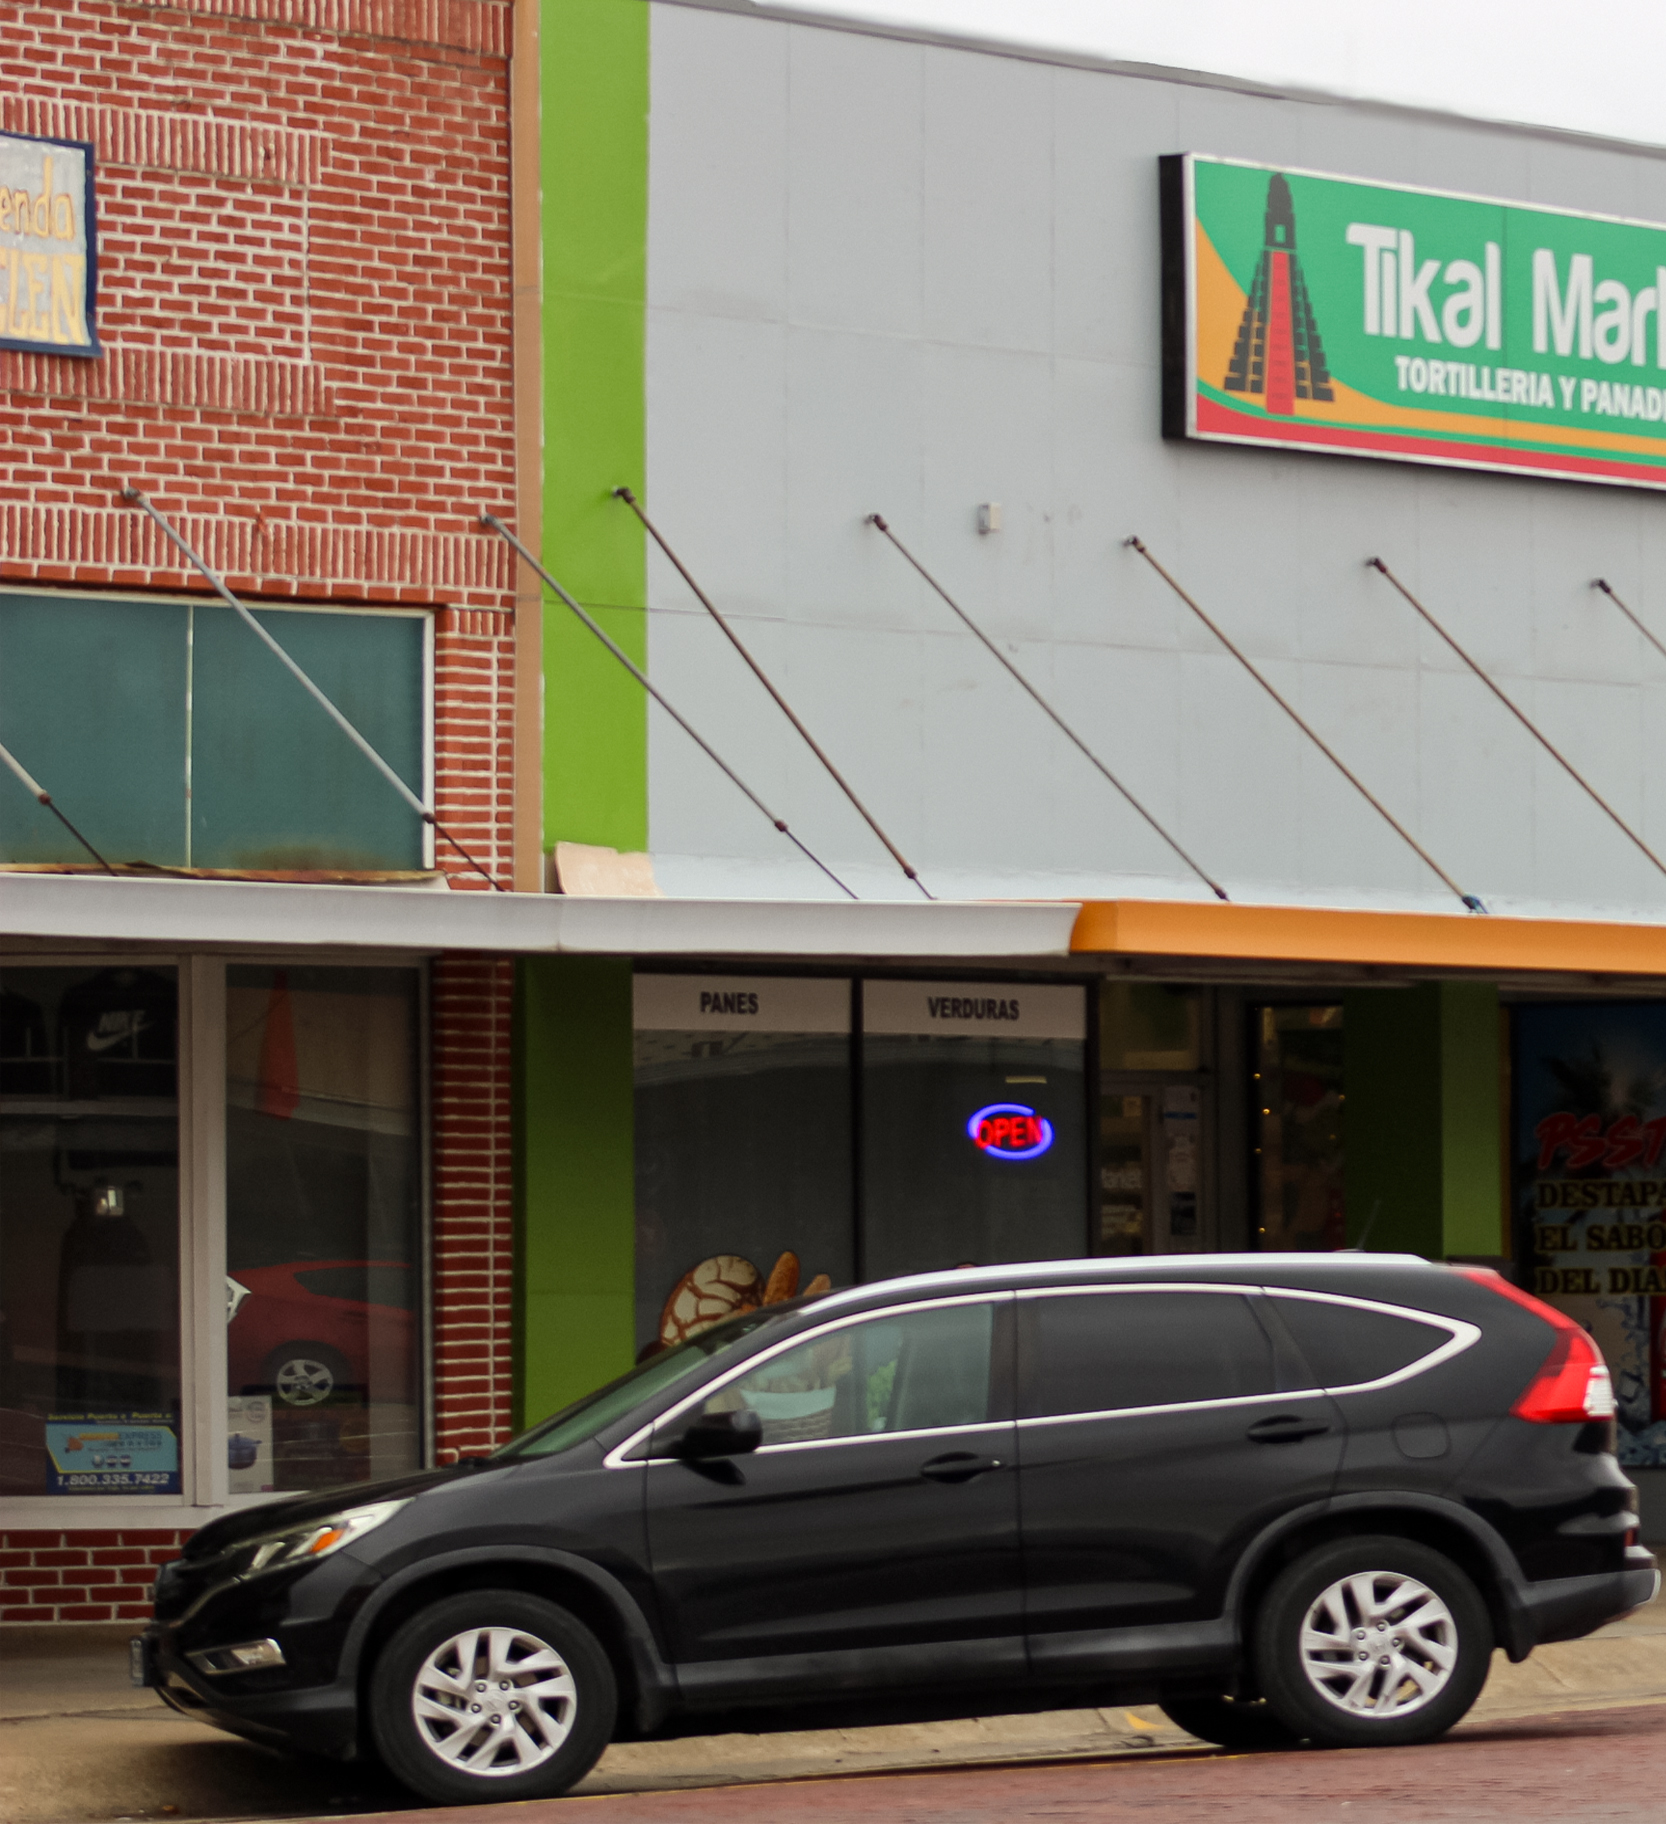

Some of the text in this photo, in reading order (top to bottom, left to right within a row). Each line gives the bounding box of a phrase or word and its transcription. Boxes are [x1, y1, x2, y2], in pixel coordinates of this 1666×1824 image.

[1346, 222, 1501, 350] Tikal
[1395, 356, 1554, 408] TORTILLERIA
[1558, 376, 1578, 411] Y
[700, 993, 759, 1014] PANES
[928, 997, 1020, 1021] VERDURAS
[973, 1117, 1043, 1149] OPEN
[1537, 1225, 1579, 1252] EL
[1538, 1269, 1600, 1294] DEL
[57, 1474, 170, 1486] 1.800.335.7422
